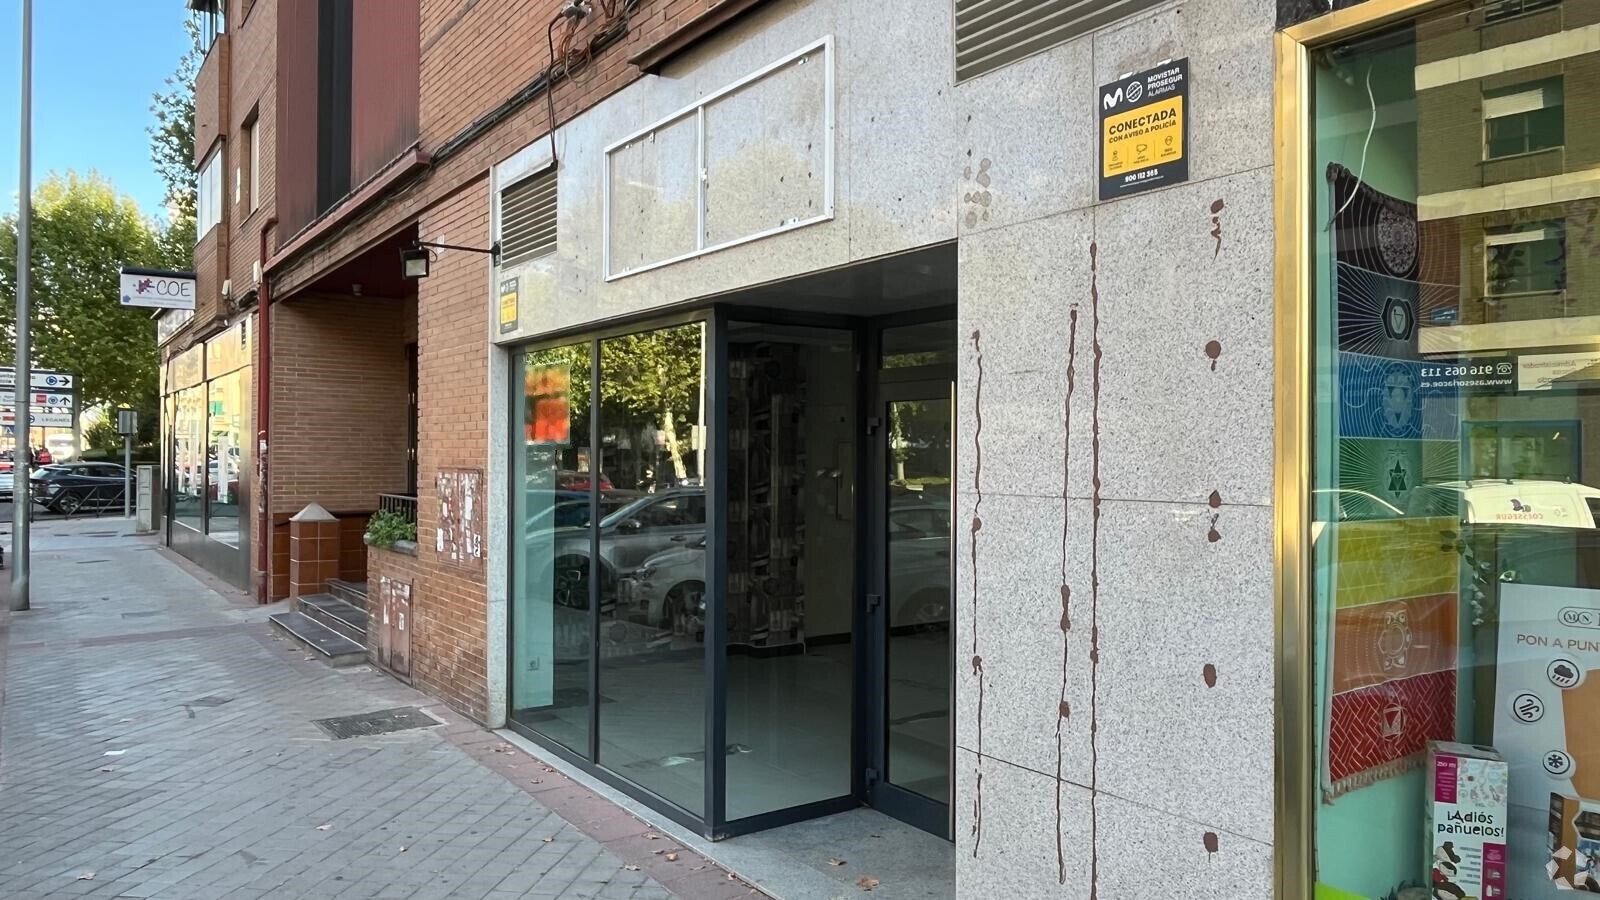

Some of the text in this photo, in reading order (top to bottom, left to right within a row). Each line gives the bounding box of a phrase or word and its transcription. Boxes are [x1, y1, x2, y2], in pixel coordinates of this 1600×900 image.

[1147, 67, 1180, 83] MOVISTAR
[1147, 74, 1183, 90] PROSEGUR
[1148, 83, 1175, 97] ALARMAS
[1109, 107, 1177, 135] CONECTADA
[1109, 135, 1123, 144] CON
[1124, 129, 1143, 140] AVISO
[1150, 119, 1177, 132] POLICÍA
[1125, 173, 1137, 182] 900
[1137, 171, 1146, 180] 112
[157, 280, 191, 297] COE
[1516, 633, 1548, 647] PON
[1552, 638, 1563, 648] A
[1447, 809, 1494, 825] ¡Adiós
[1437, 821, 1505, 838] pañuelos!
